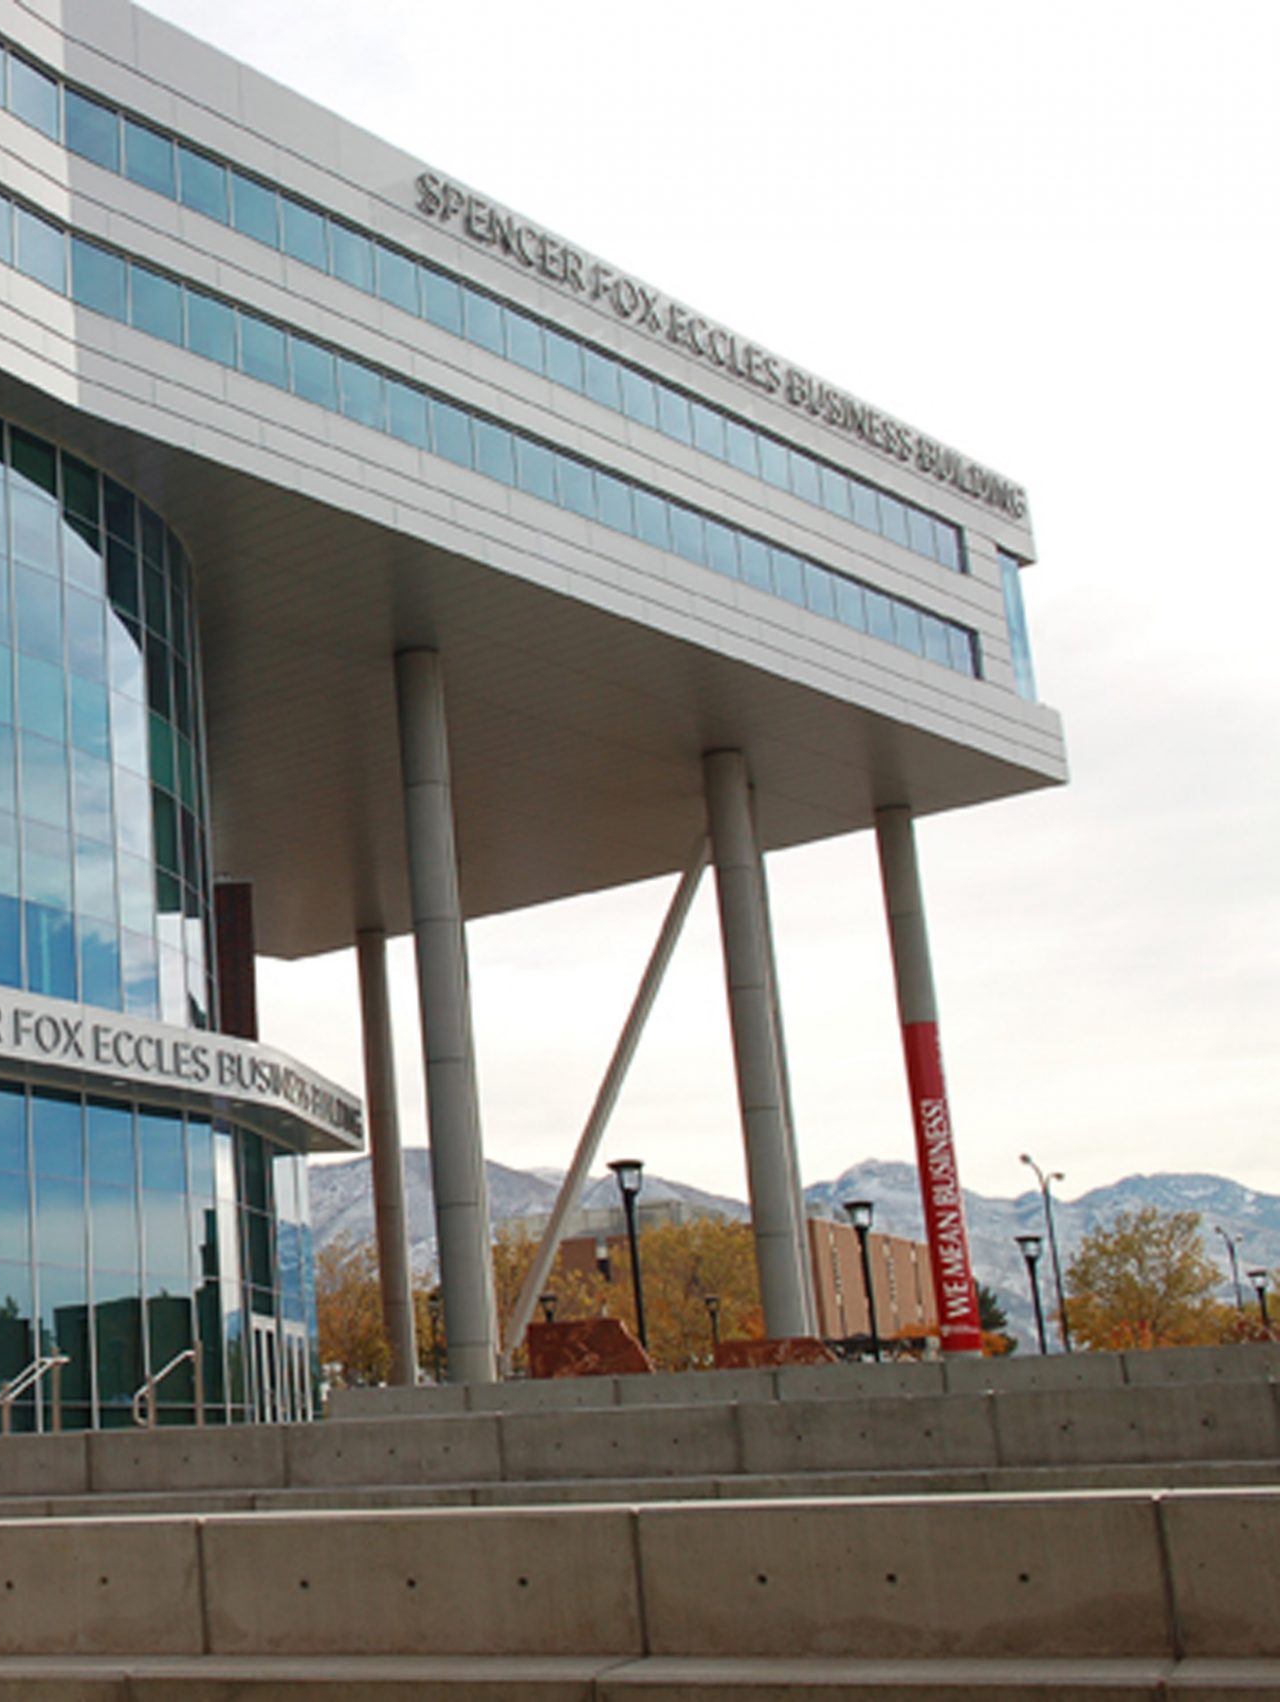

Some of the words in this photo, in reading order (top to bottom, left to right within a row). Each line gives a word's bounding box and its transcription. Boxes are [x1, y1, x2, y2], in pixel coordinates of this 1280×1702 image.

[416, 172, 585, 298] SPENCER
[587, 262, 661, 332] FOX
[667, 304, 781, 394] ECCLES
[786, 367, 912, 462] BUSINESS
[916, 436, 1026, 519] BUILDING
[13, 1007, 85, 1058] FOX
[95, 1027, 210, 1083] ECCLES
[935, 1211, 970, 1277] MEAN
[942, 1280, 972, 1318] WE
